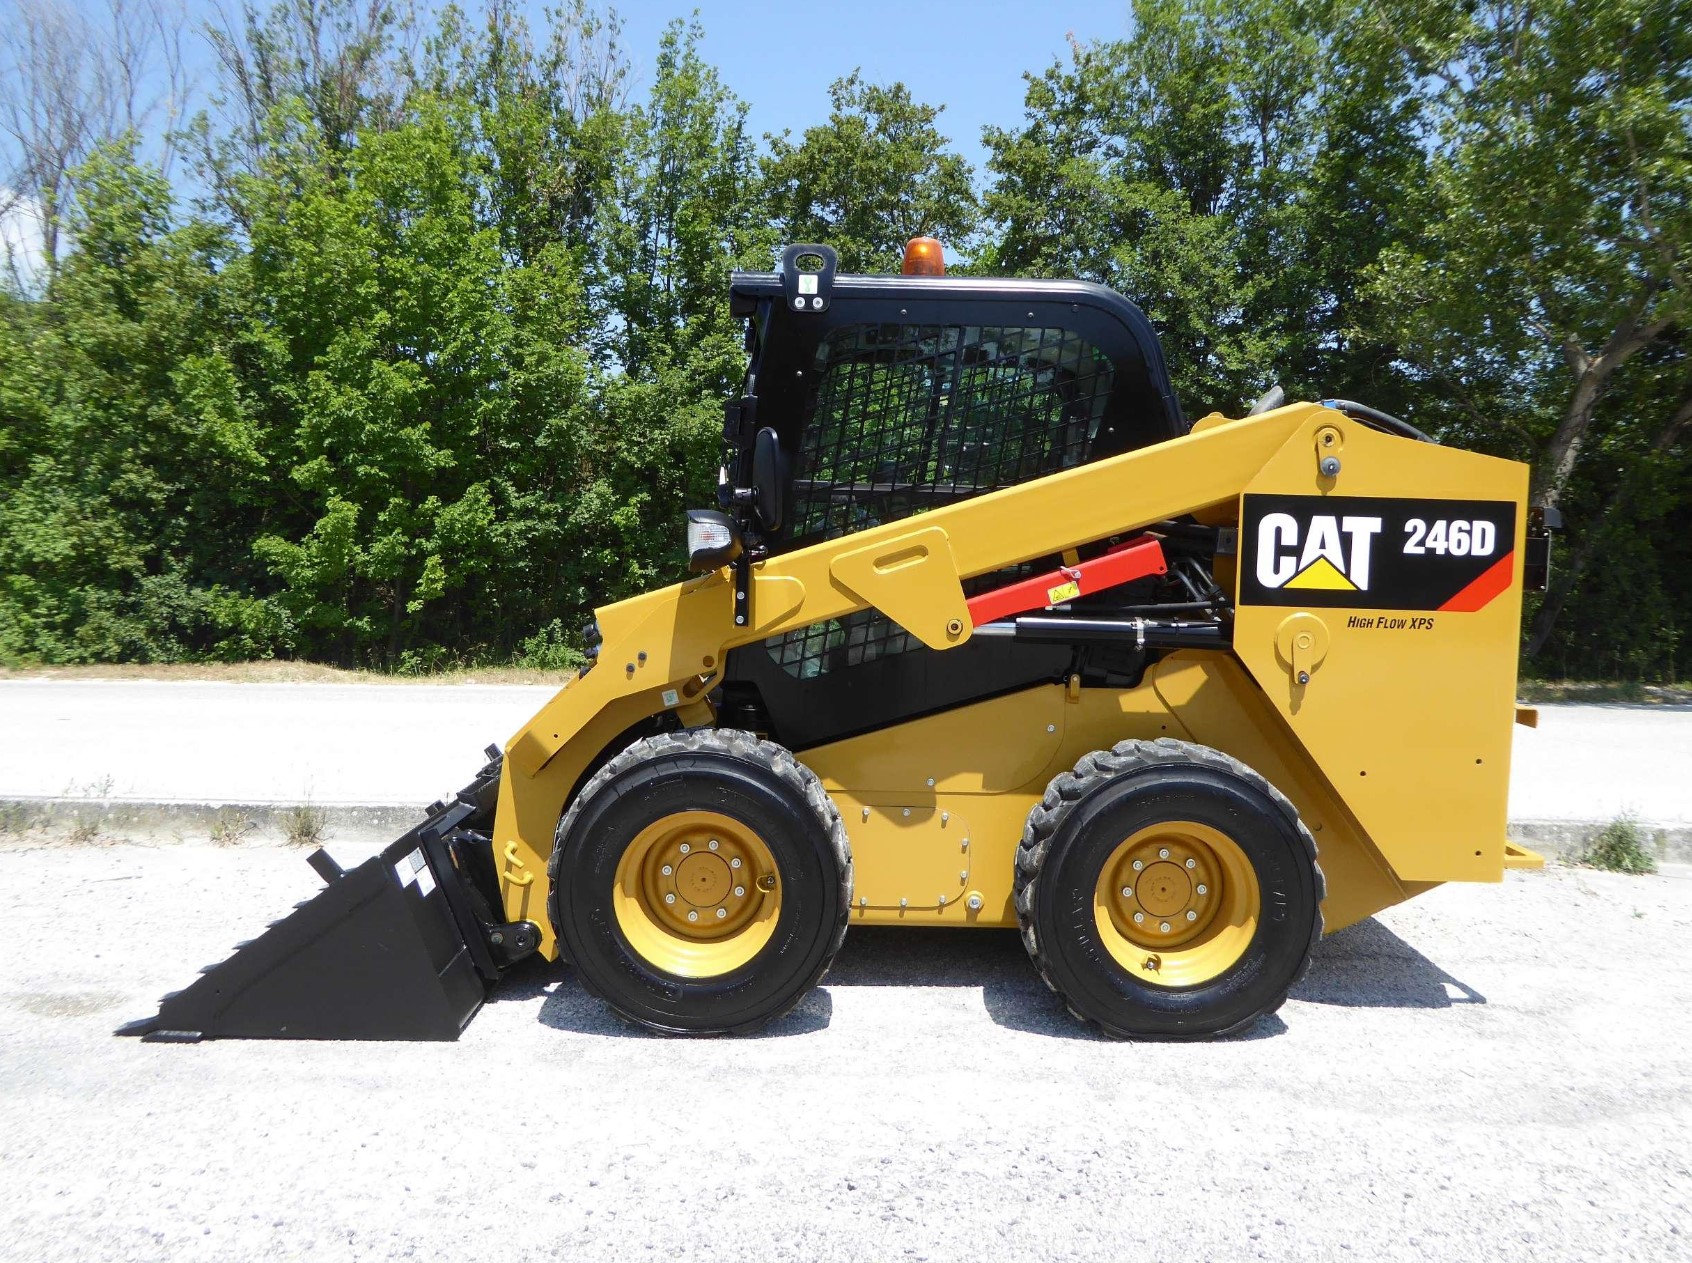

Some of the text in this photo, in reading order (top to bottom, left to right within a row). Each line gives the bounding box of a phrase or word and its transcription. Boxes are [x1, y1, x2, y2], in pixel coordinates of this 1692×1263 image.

[1256, 512, 1382, 590] CAT
[1403, 518, 1496, 556] 246D
[1409, 617, 1434, 630] XPS
